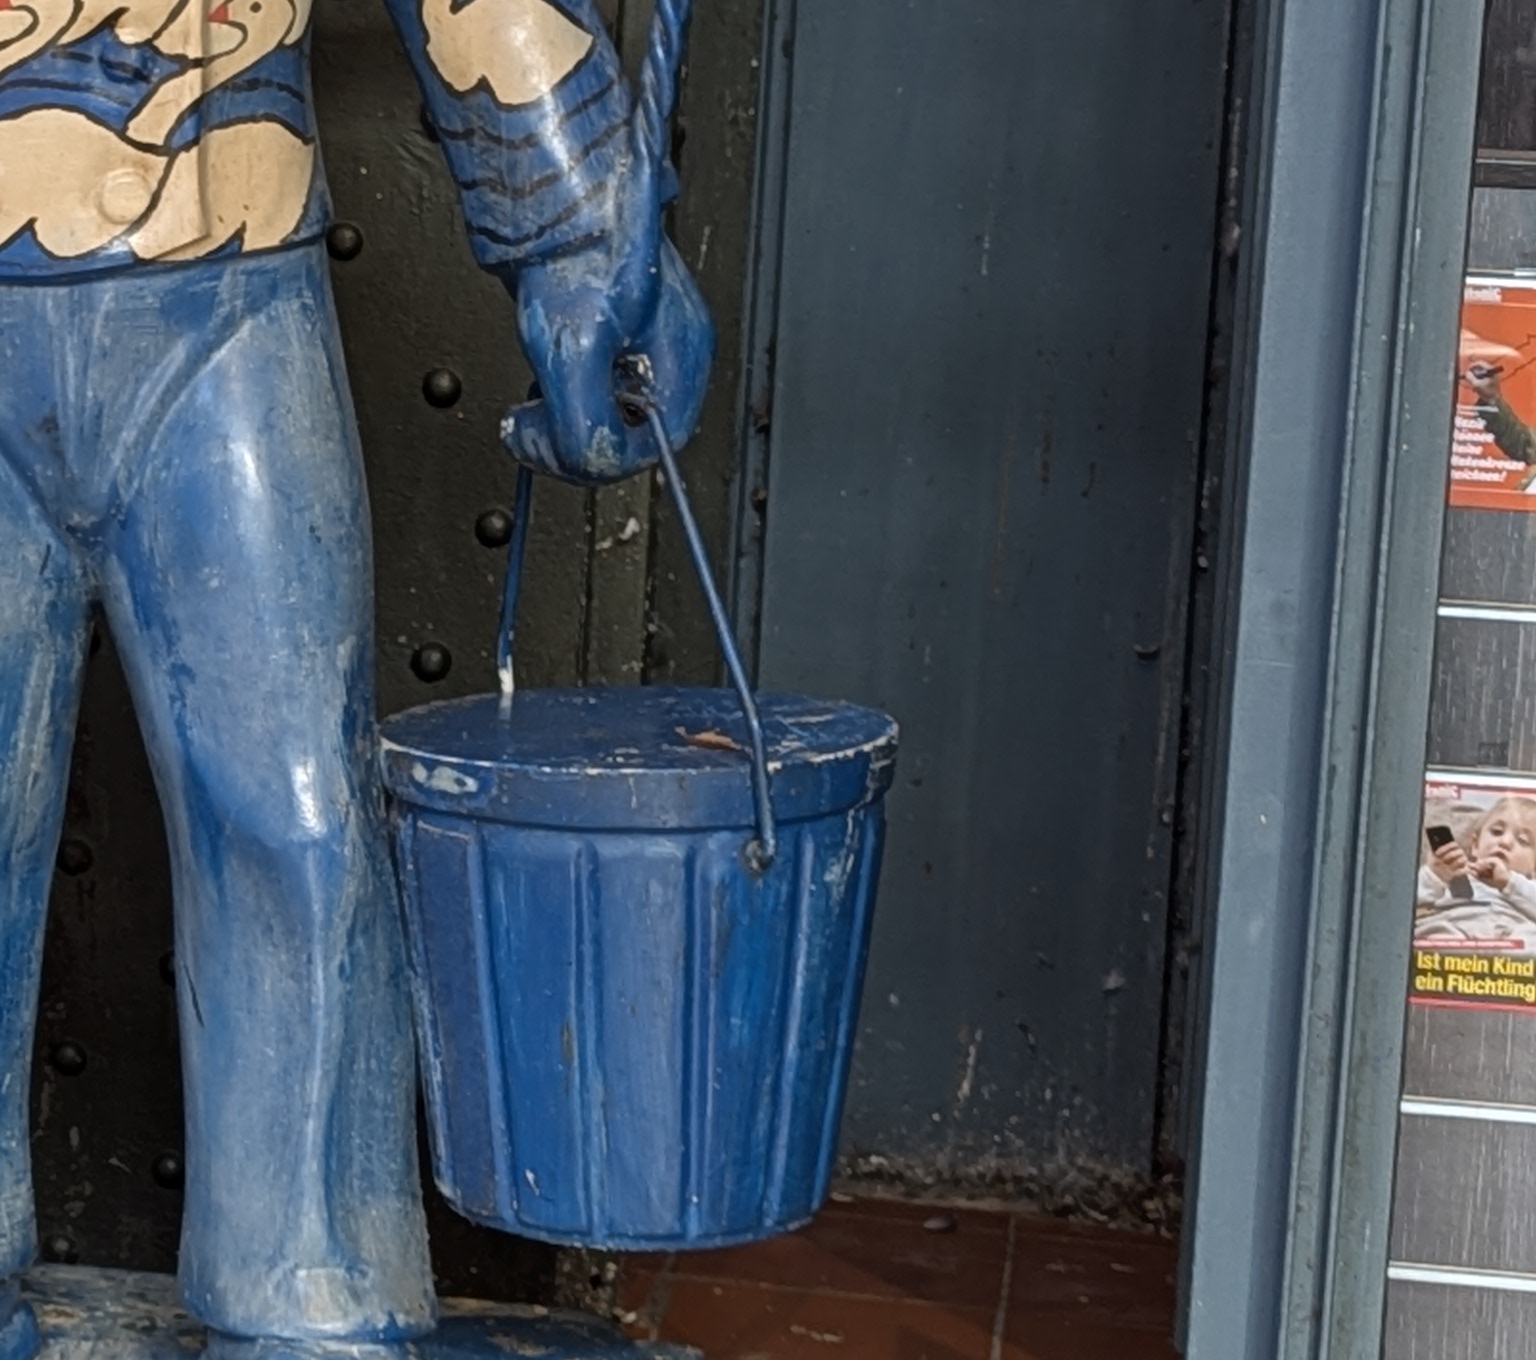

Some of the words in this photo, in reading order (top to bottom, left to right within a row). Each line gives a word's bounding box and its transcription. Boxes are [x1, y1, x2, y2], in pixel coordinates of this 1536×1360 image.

[1417, 951, 1441, 970] Ist
[1444, 954, 1489, 974] mein
[1492, 956, 1535, 977] Kind
[1415, 972, 1444, 992] ein
[1447, 973, 1536, 1003] Flüchtling
